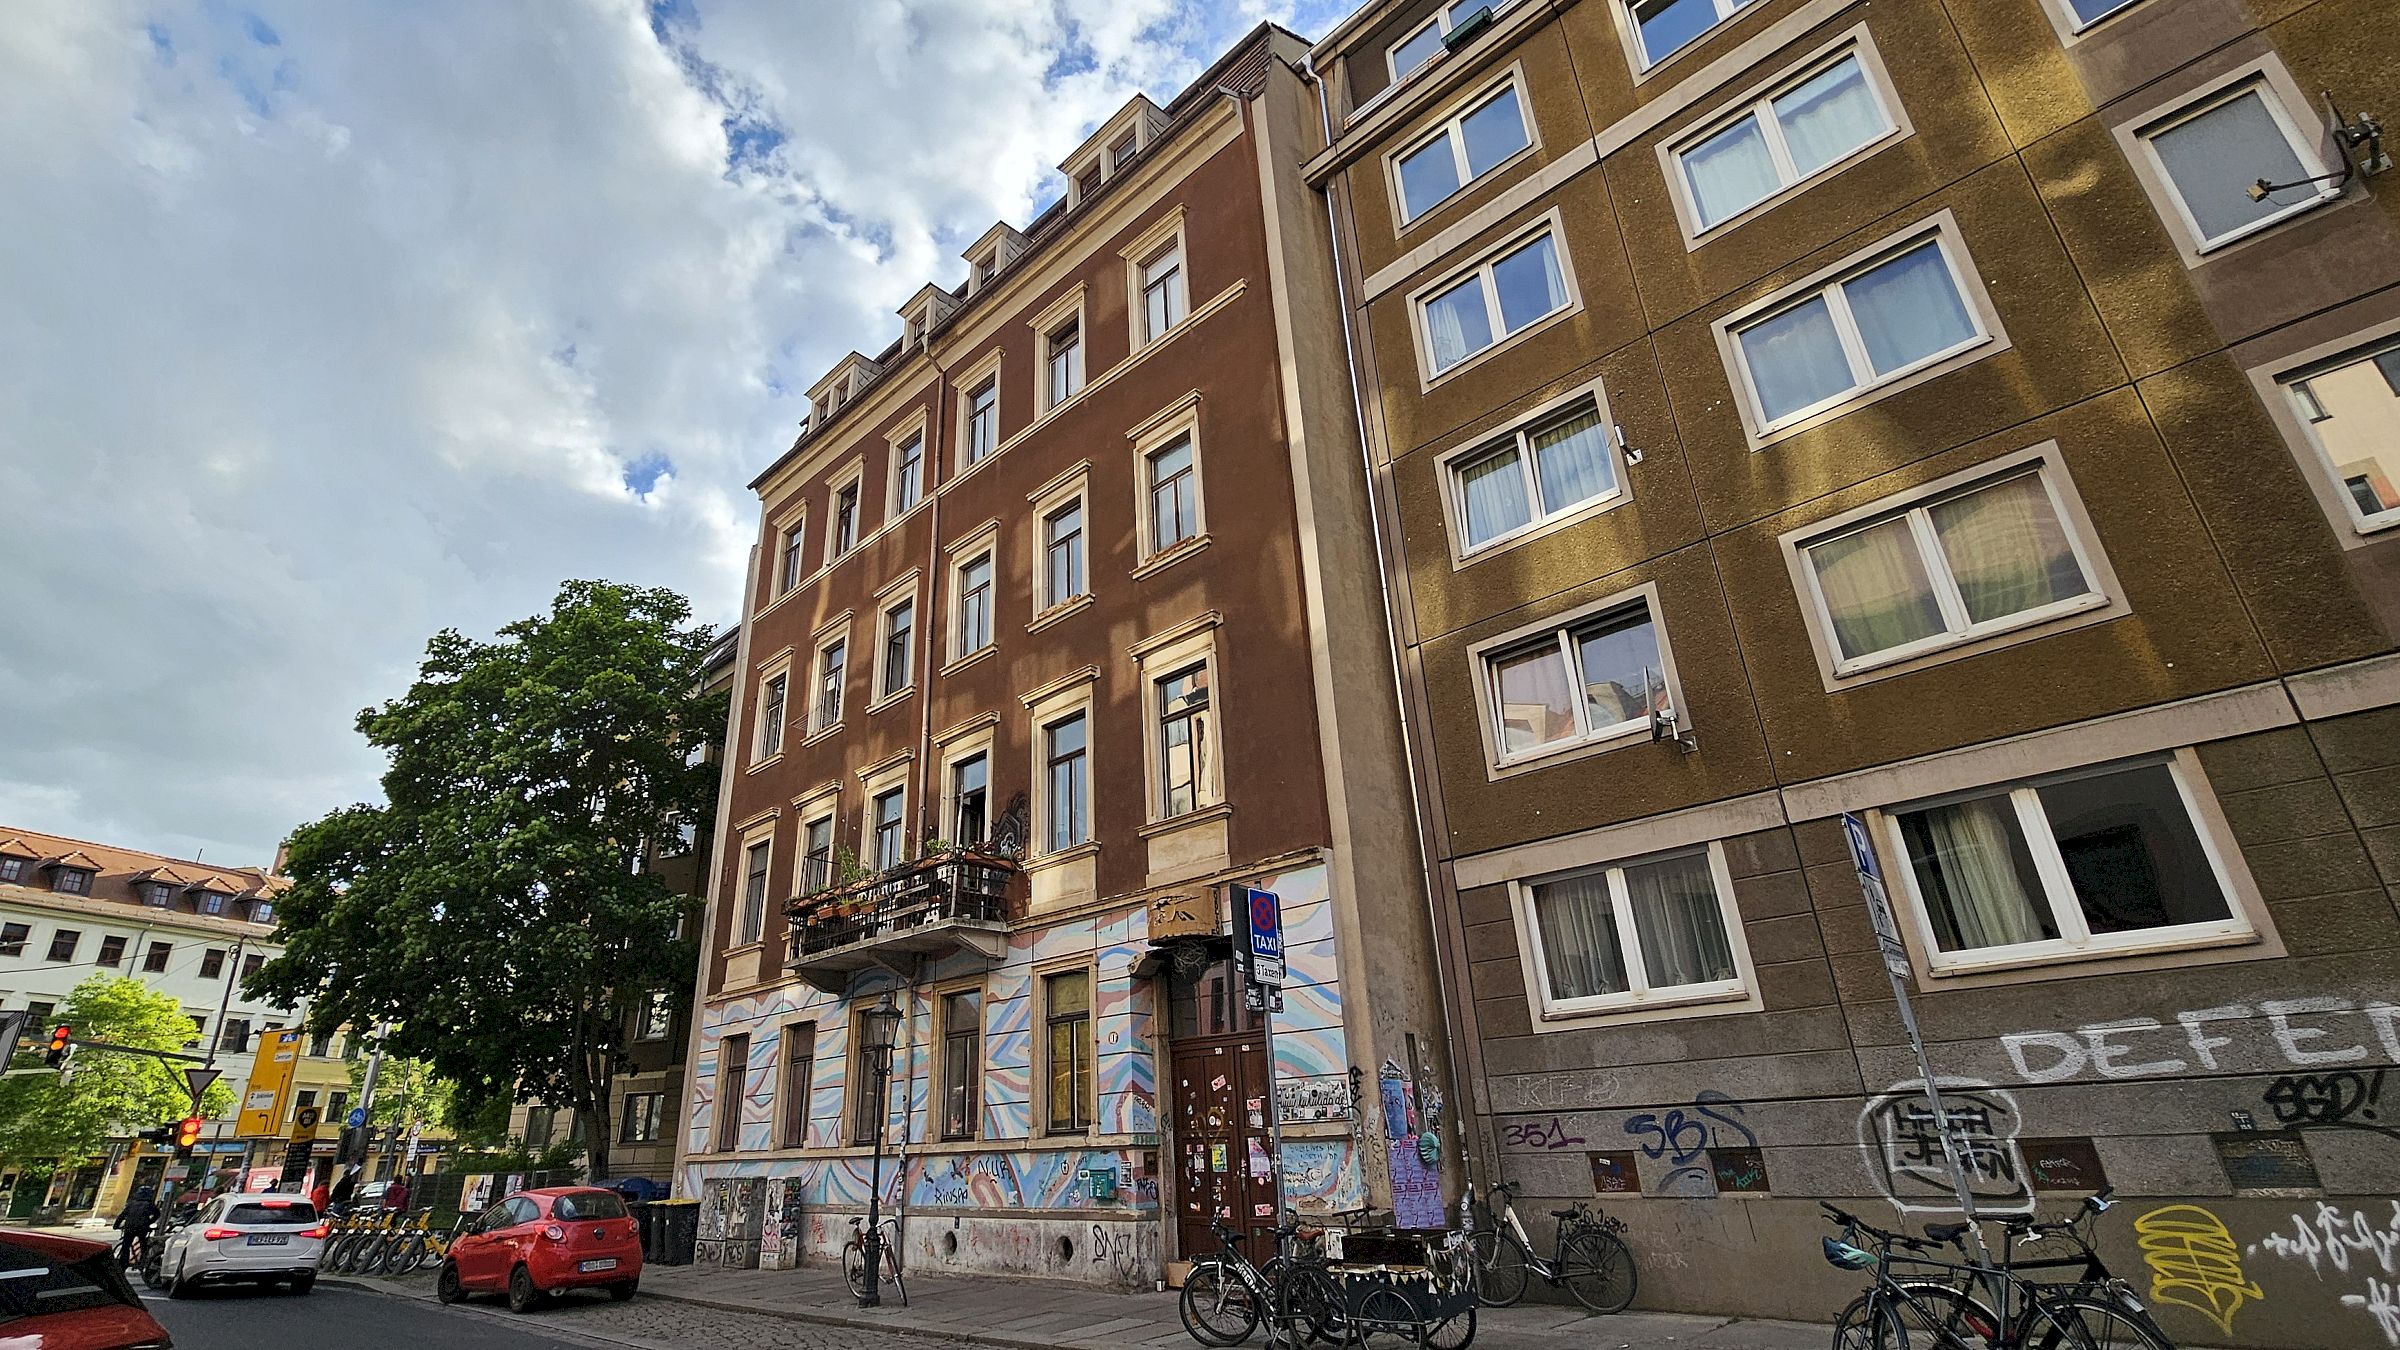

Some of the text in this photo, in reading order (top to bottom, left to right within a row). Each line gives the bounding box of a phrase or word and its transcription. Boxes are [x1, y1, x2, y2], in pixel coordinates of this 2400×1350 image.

[1850, 823, 1867, 867] P
[1253, 934, 1277, 952] TAXI
[1256, 964, 1279, 979] 3 Taxen
[1503, 1117, 1585, 1150] 351
